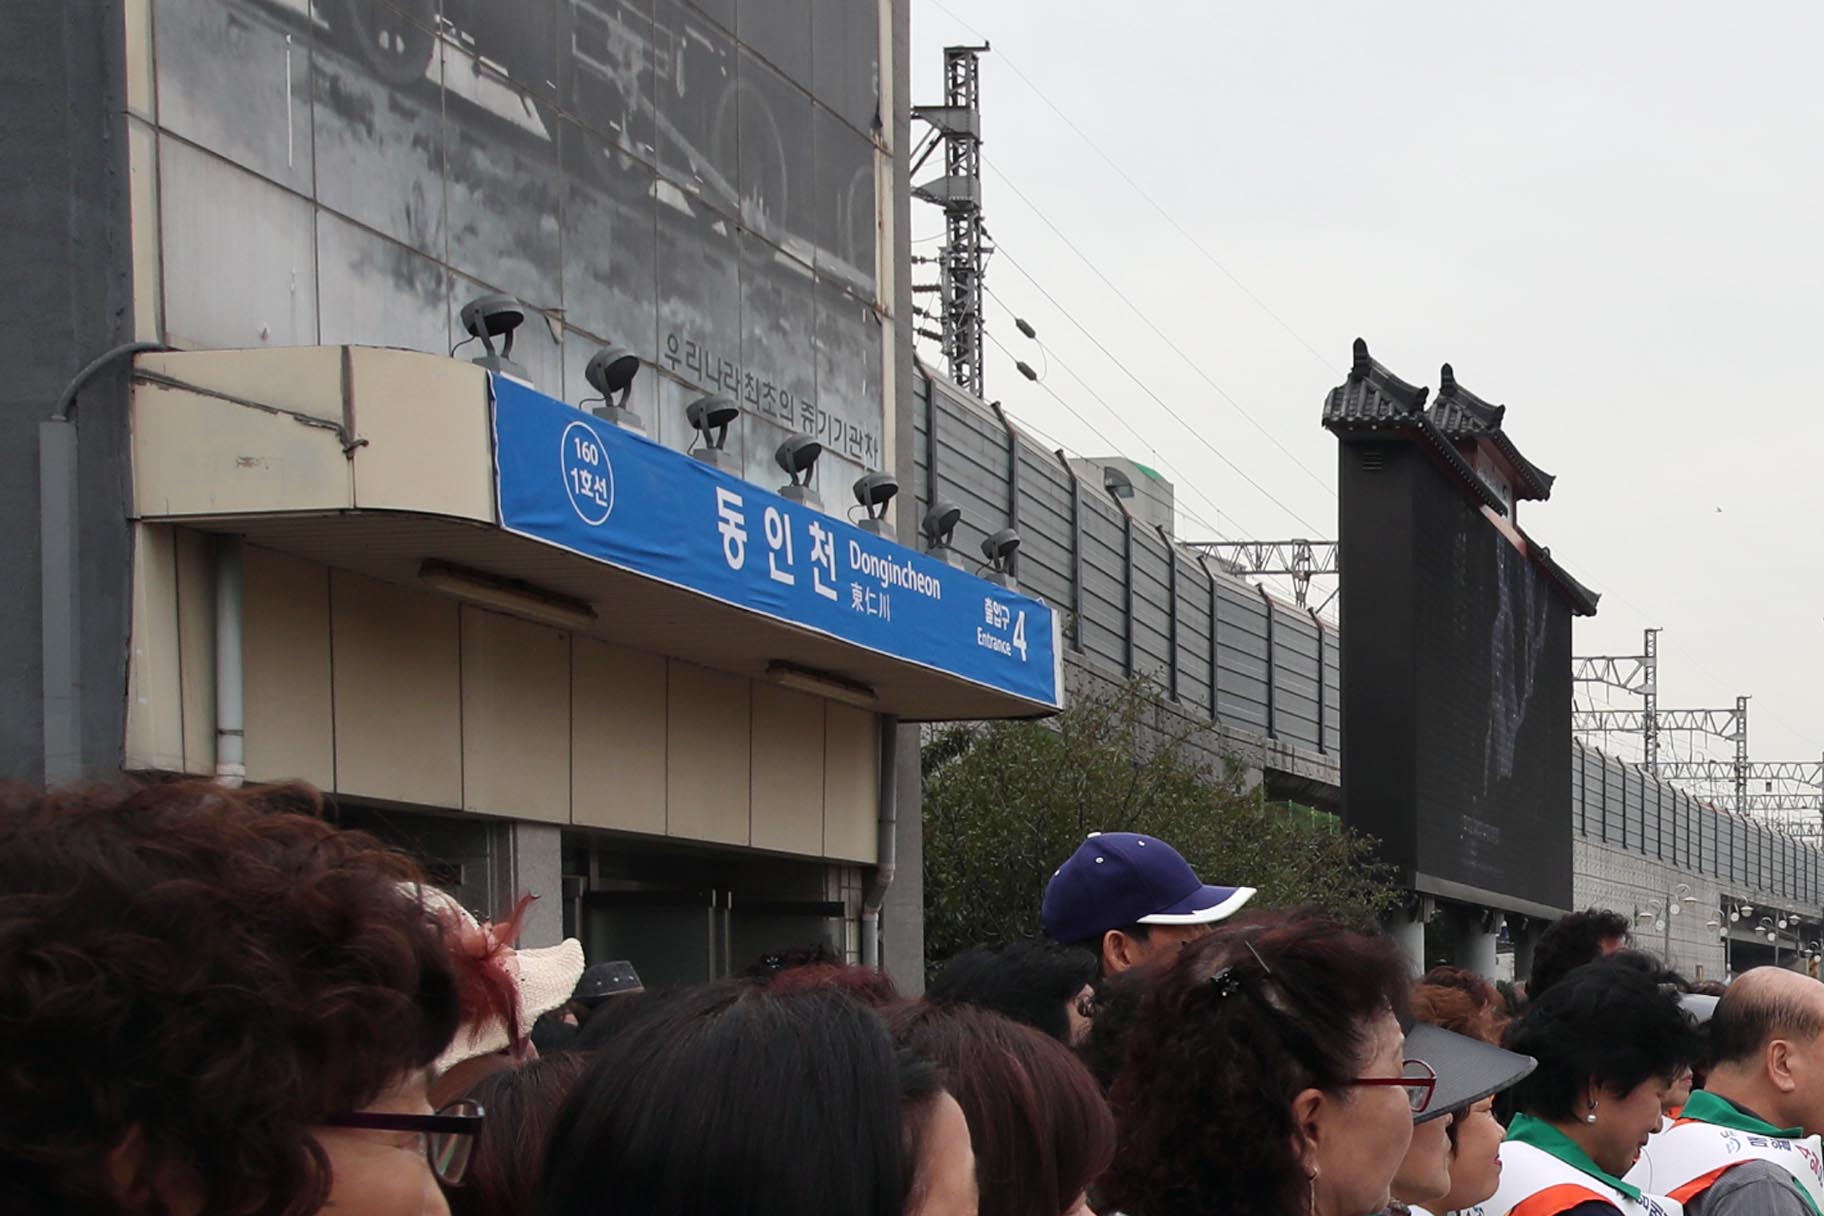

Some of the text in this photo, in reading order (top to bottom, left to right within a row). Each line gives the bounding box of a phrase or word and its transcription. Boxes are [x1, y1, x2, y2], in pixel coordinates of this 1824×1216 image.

[664, 333, 741, 400] 우리나라
[744, 371, 794, 426] 최초의
[574, 437, 599, 466] 160
[570, 467, 608, 507] 1호선
[716, 486, 838, 602] 동인천
[849, 540, 941, 600] Dongincheon
[850, 581, 891, 622] 東仁川
[984, 597, 1011, 628] 출입구
[976, 627, 1012, 657] Entrance
[1012, 610, 1028, 662] 4
